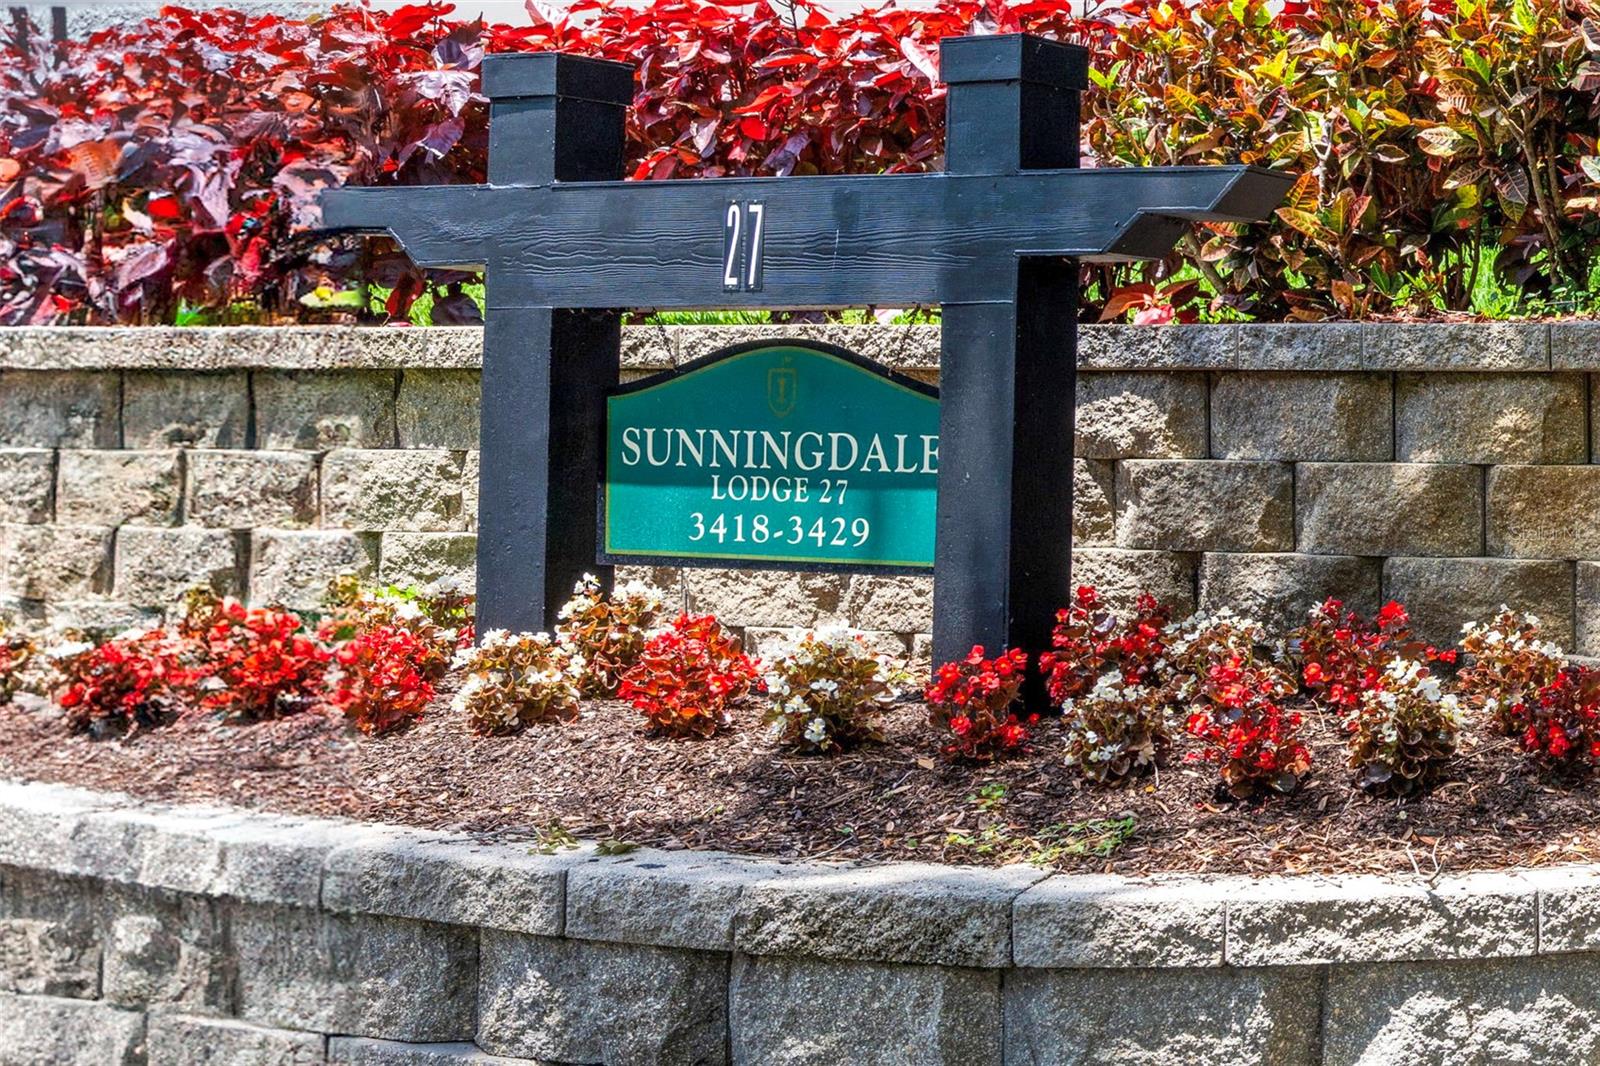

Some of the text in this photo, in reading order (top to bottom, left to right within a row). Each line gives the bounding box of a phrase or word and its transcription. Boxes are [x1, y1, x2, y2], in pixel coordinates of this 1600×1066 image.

[725, 205, 762, 285] 27
[622, 427, 939, 473] SUNNINGDALE
[711, 475, 848, 505] LODGE 27
[689, 513, 870, 547] 3418-3429
